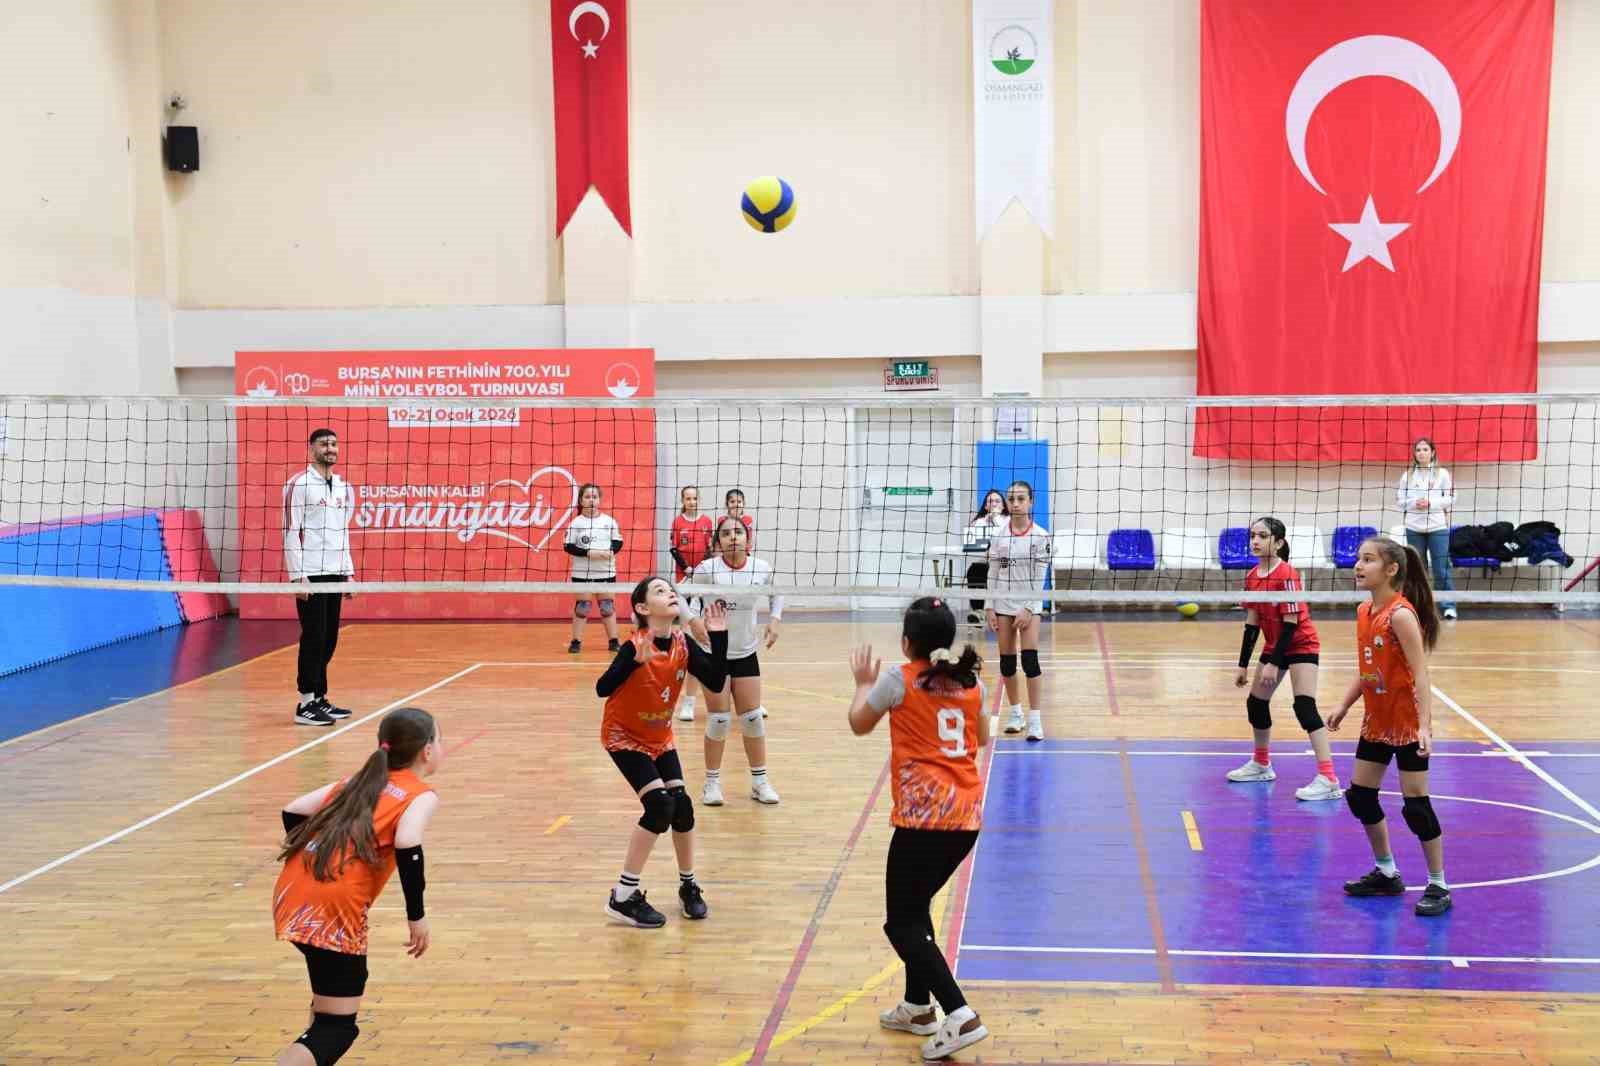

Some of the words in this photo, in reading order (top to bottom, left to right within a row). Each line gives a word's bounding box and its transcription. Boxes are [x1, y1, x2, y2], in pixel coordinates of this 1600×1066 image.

[338, 366, 424, 380] BURSA'NIN
[427, 362, 501, 379] FETHİNİN
[344, 382, 380, 397] MİNİ
[382, 383, 467, 397] VOLEYBOL
[470, 382, 565, 396] TURNUVASI
[392, 408, 432, 421] 19-21
[435, 408, 474, 421] Ocak
[478, 408, 517, 421] 2026
[359, 485, 438, 498] BURSA'NIN
[440, 481, 485, 497] KALBİ
[355, 493, 552, 542] smangazi
[661, 686, 671, 703] 4
[936, 708, 968, 758] 9
